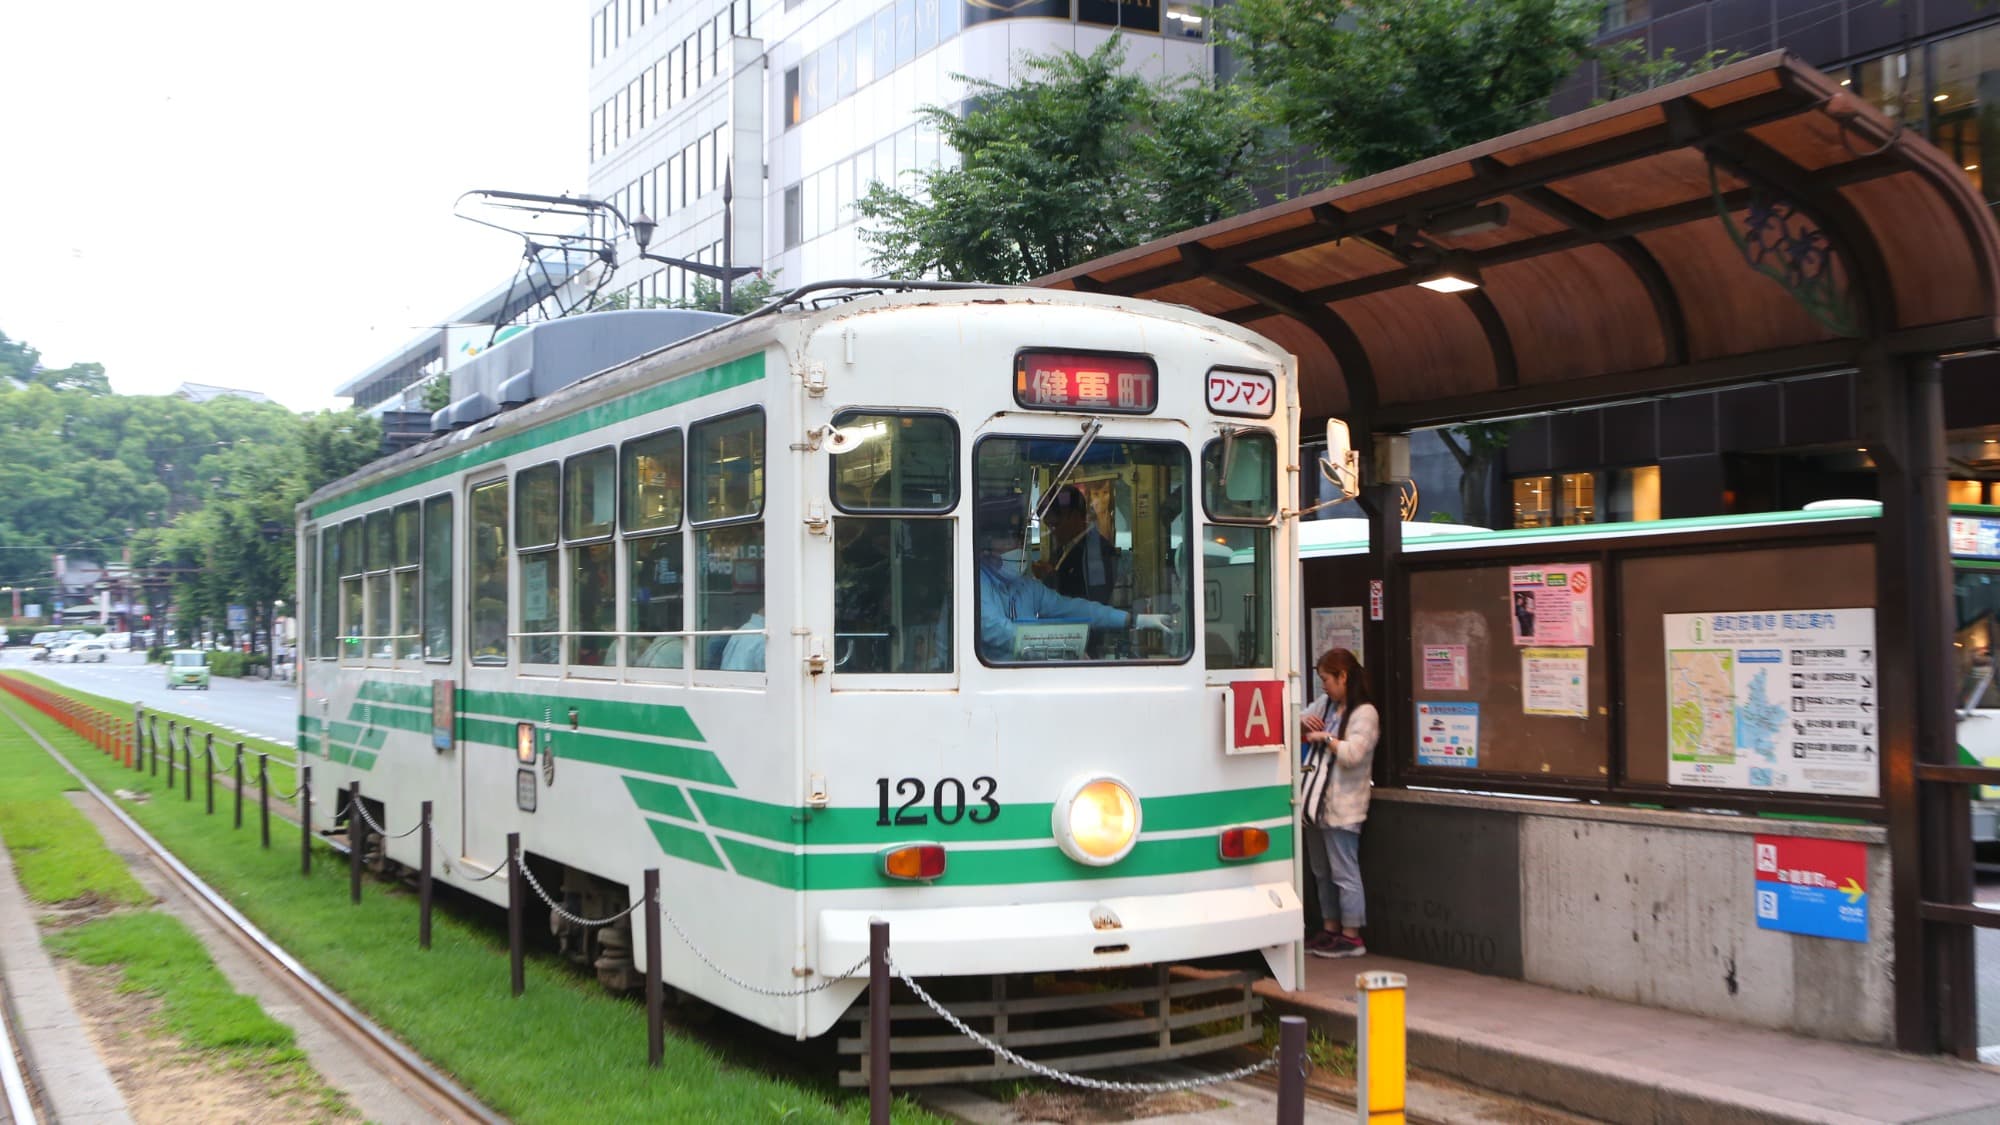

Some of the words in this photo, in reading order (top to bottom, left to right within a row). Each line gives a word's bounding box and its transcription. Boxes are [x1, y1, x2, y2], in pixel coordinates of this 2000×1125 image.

[1032, 368, 1150, 408] 健軍町
[1210, 378, 1271, 406] ワンマン
[1244, 687, 1270, 739] A
[876, 776, 1000, 827] 1203
